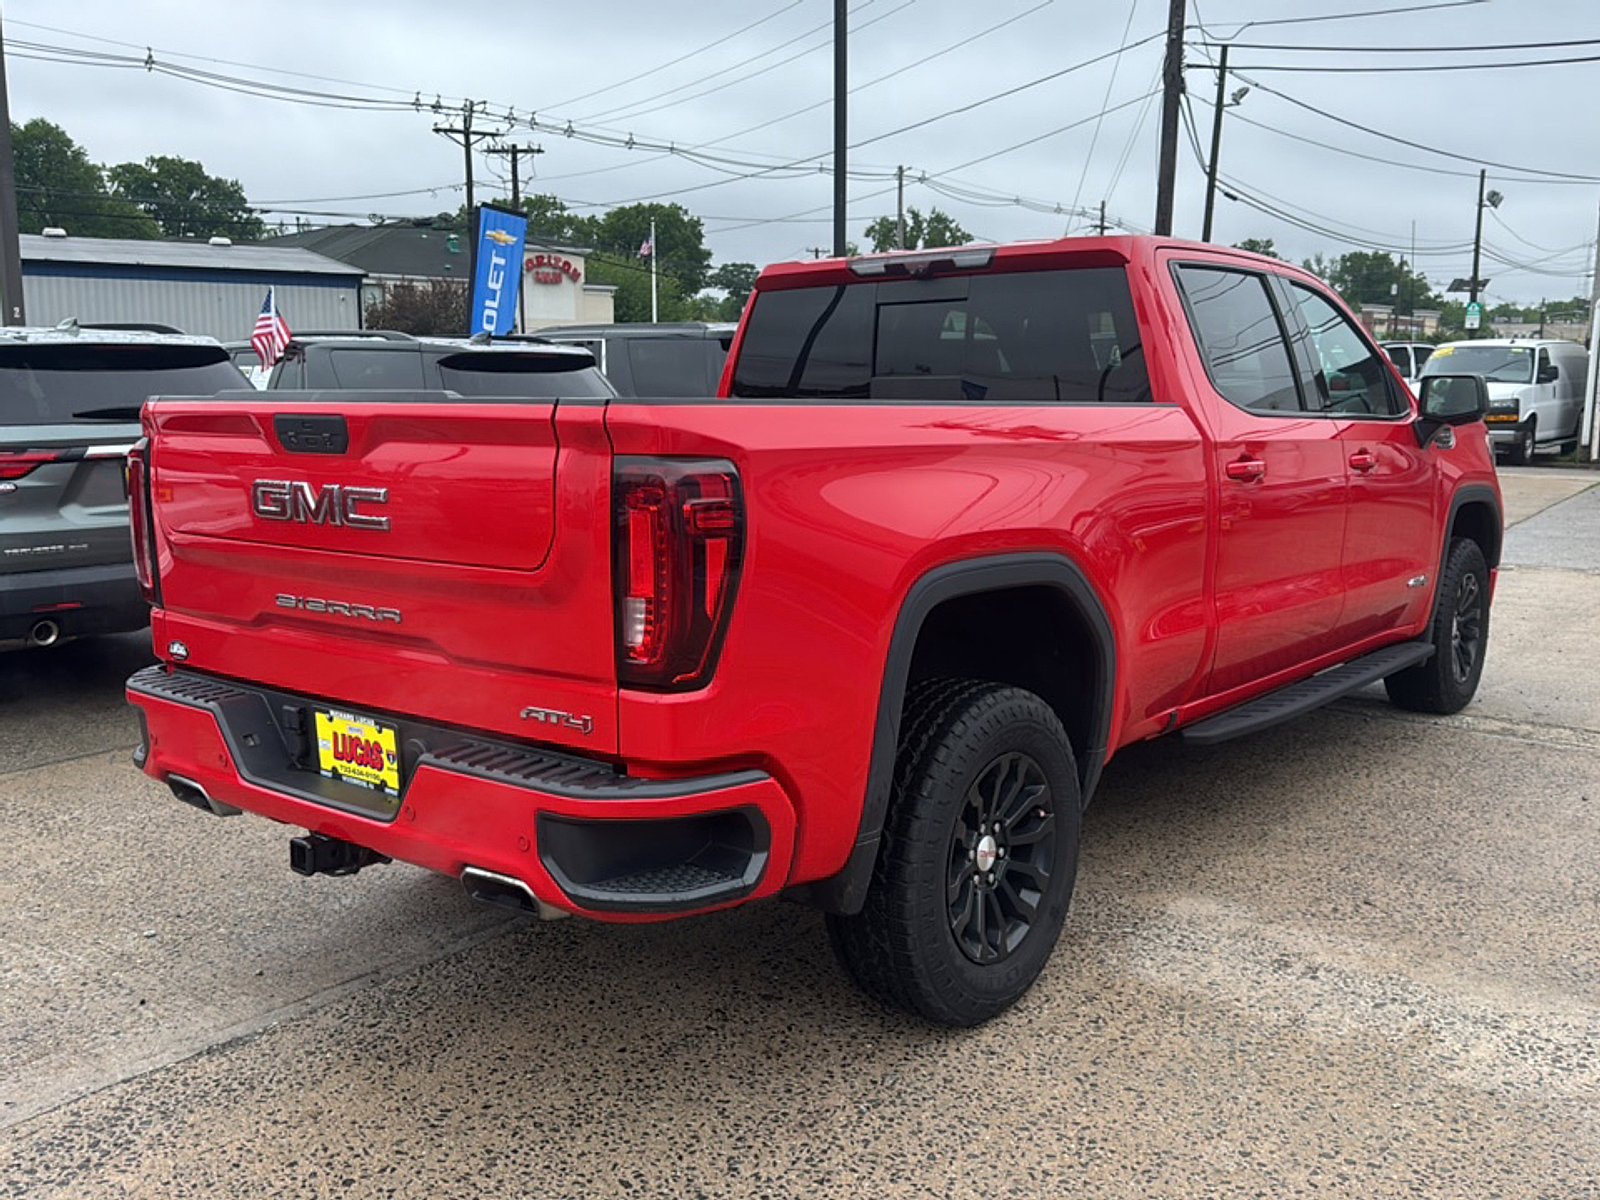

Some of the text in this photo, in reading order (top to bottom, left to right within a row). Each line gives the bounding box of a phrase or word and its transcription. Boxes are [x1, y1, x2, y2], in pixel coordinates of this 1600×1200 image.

[482, 250, 507, 333] OLET
[253, 478, 391, 532] GMC
[275, 593, 402, 624] SIERRA
[520, 706, 593, 734] AT4
[333, 731, 384, 771] LUCAS
